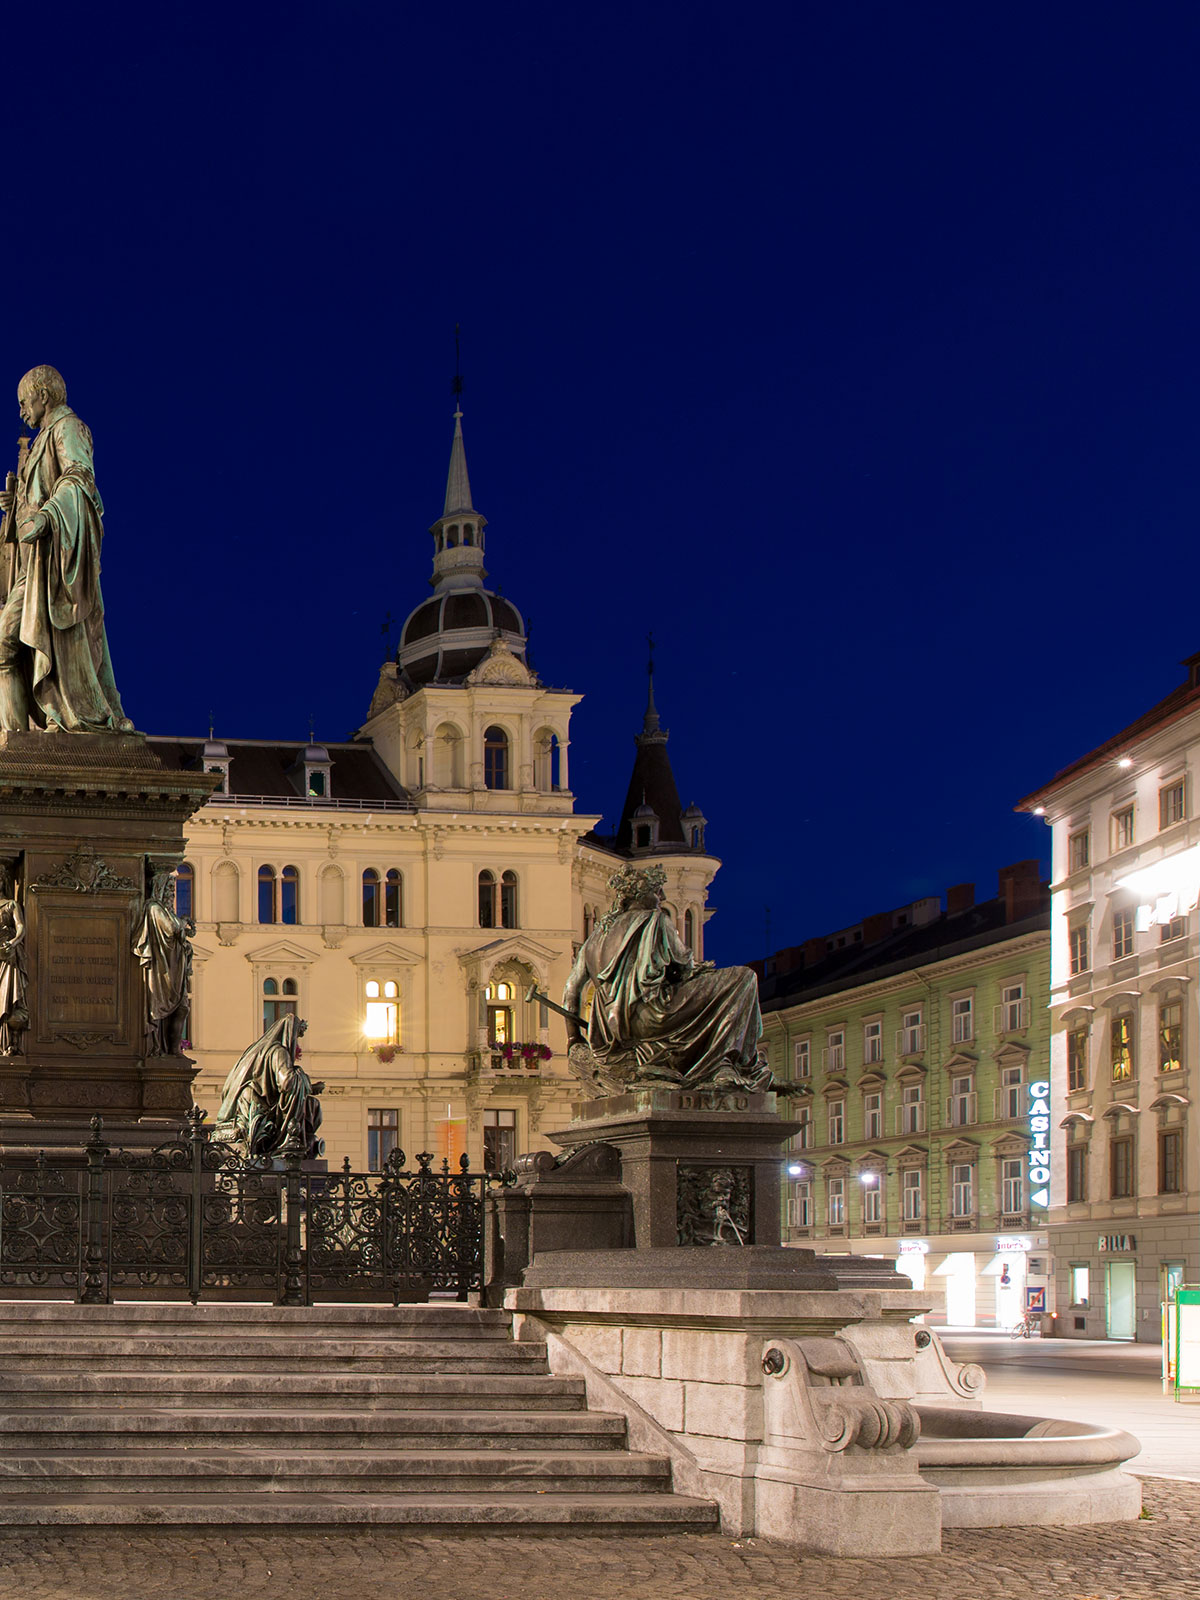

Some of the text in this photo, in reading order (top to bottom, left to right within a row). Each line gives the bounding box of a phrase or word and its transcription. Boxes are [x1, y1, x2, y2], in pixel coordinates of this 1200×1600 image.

[679, 1095, 749, 1111] DRAU
[1029, 1081, 1050, 1184] CASINO
[1098, 1235, 1133, 1252] BILLA
